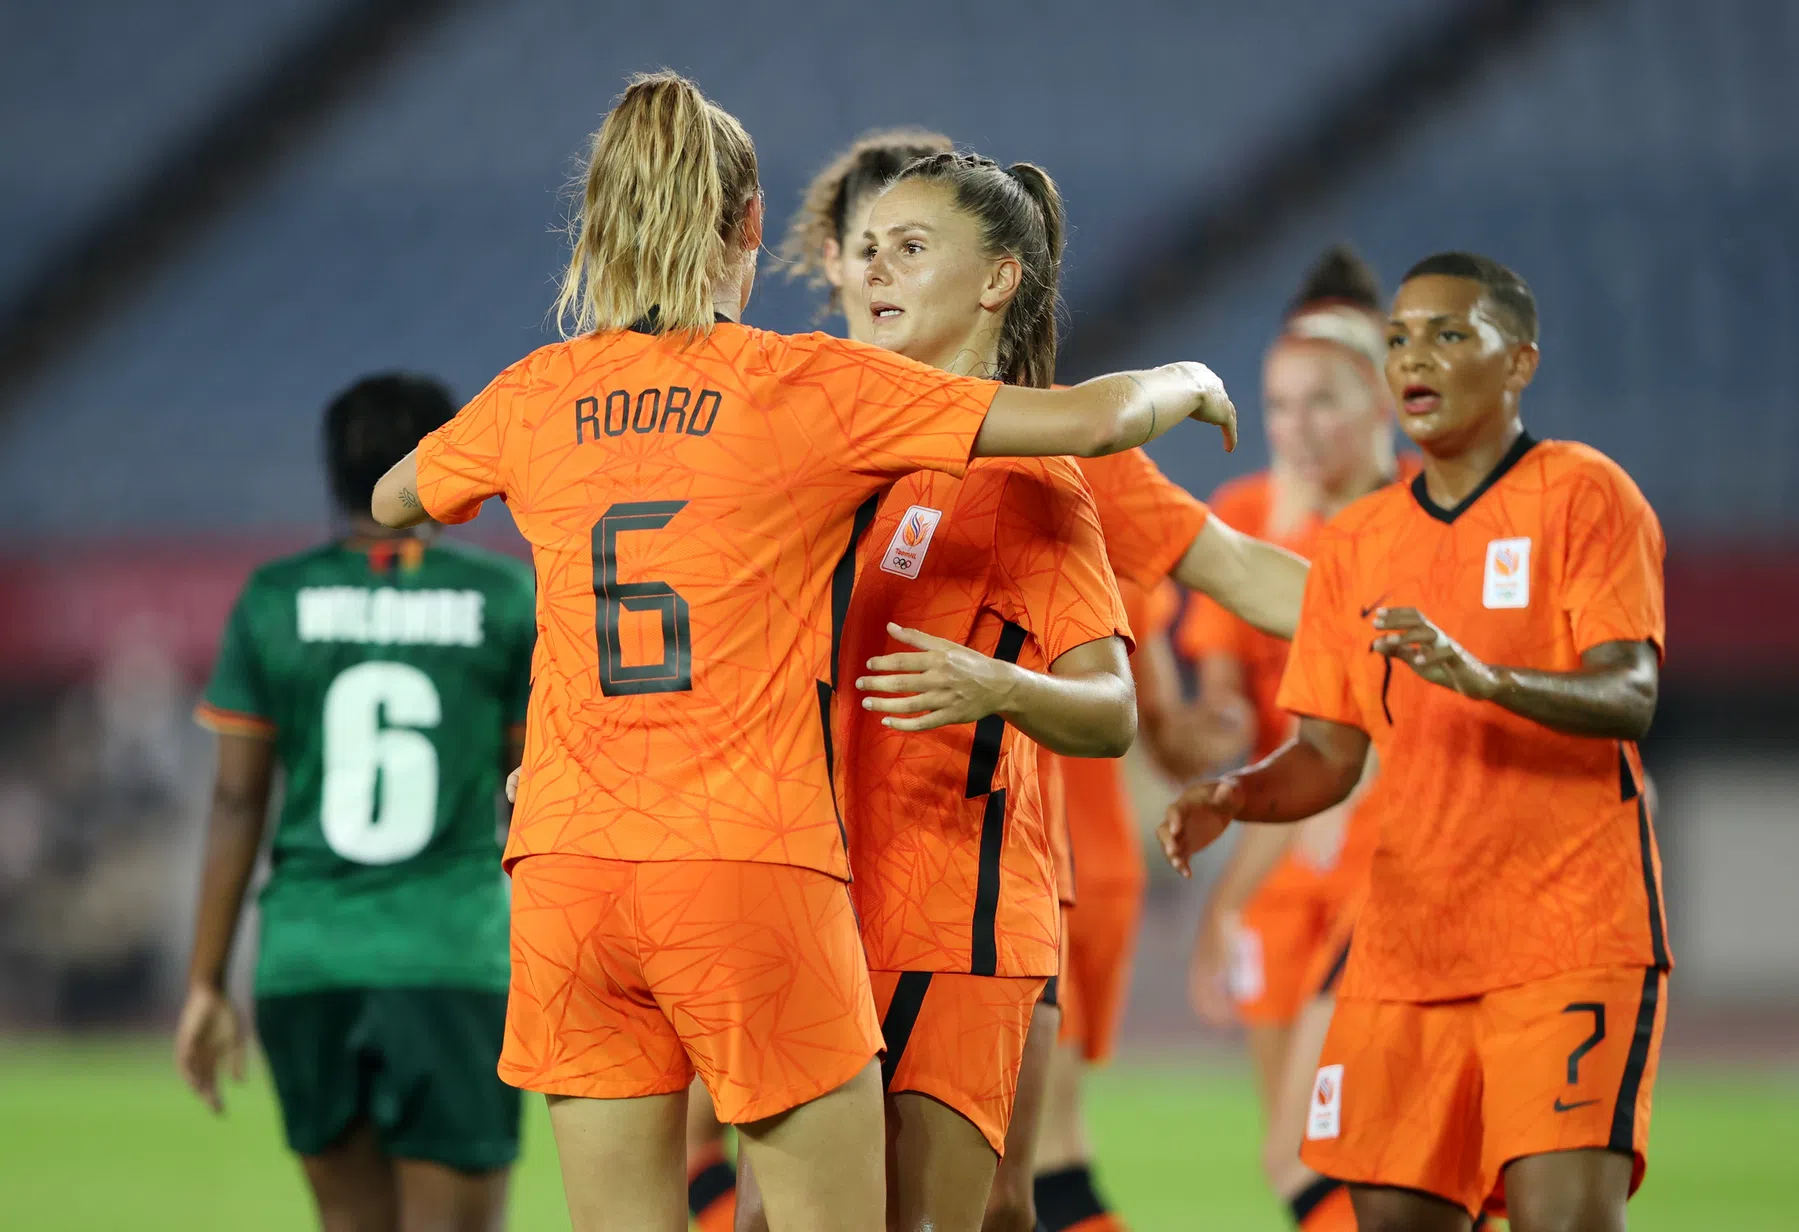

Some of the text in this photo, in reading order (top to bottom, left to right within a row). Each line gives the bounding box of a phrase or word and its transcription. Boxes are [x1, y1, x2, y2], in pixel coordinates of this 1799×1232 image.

[575, 386, 722, 445] ROORD
[591, 499, 693, 697] 6
[320, 660, 442, 866] 6
[1562, 1003, 1606, 1085] 7
